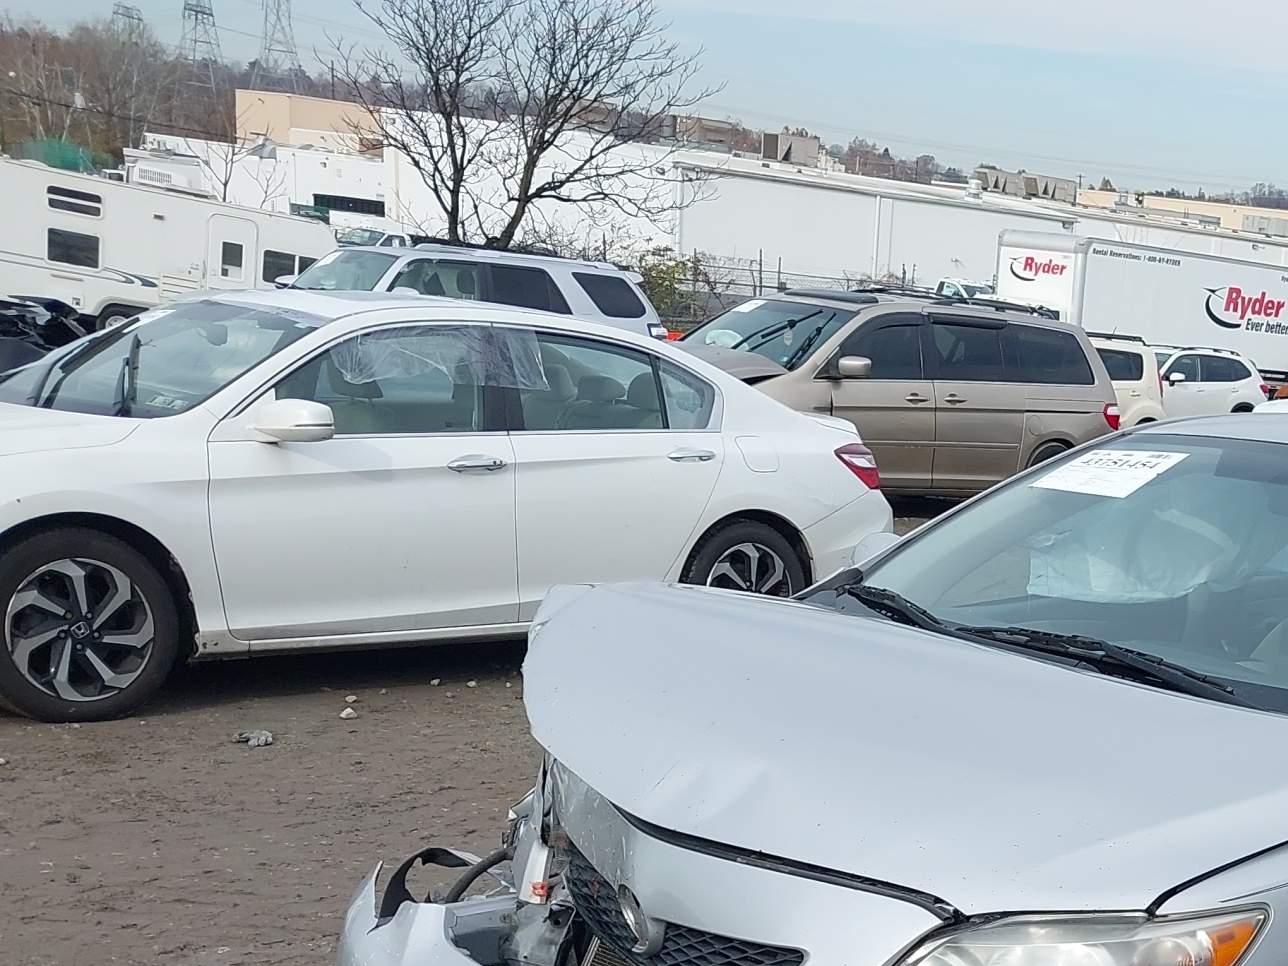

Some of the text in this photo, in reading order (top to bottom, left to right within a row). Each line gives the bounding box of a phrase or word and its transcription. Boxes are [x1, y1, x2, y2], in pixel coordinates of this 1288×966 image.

[1023, 256, 1067, 276] Ryder
[1224, 286, 1285, 320] Ryder
[1245, 318, 1265, 333] Ever
